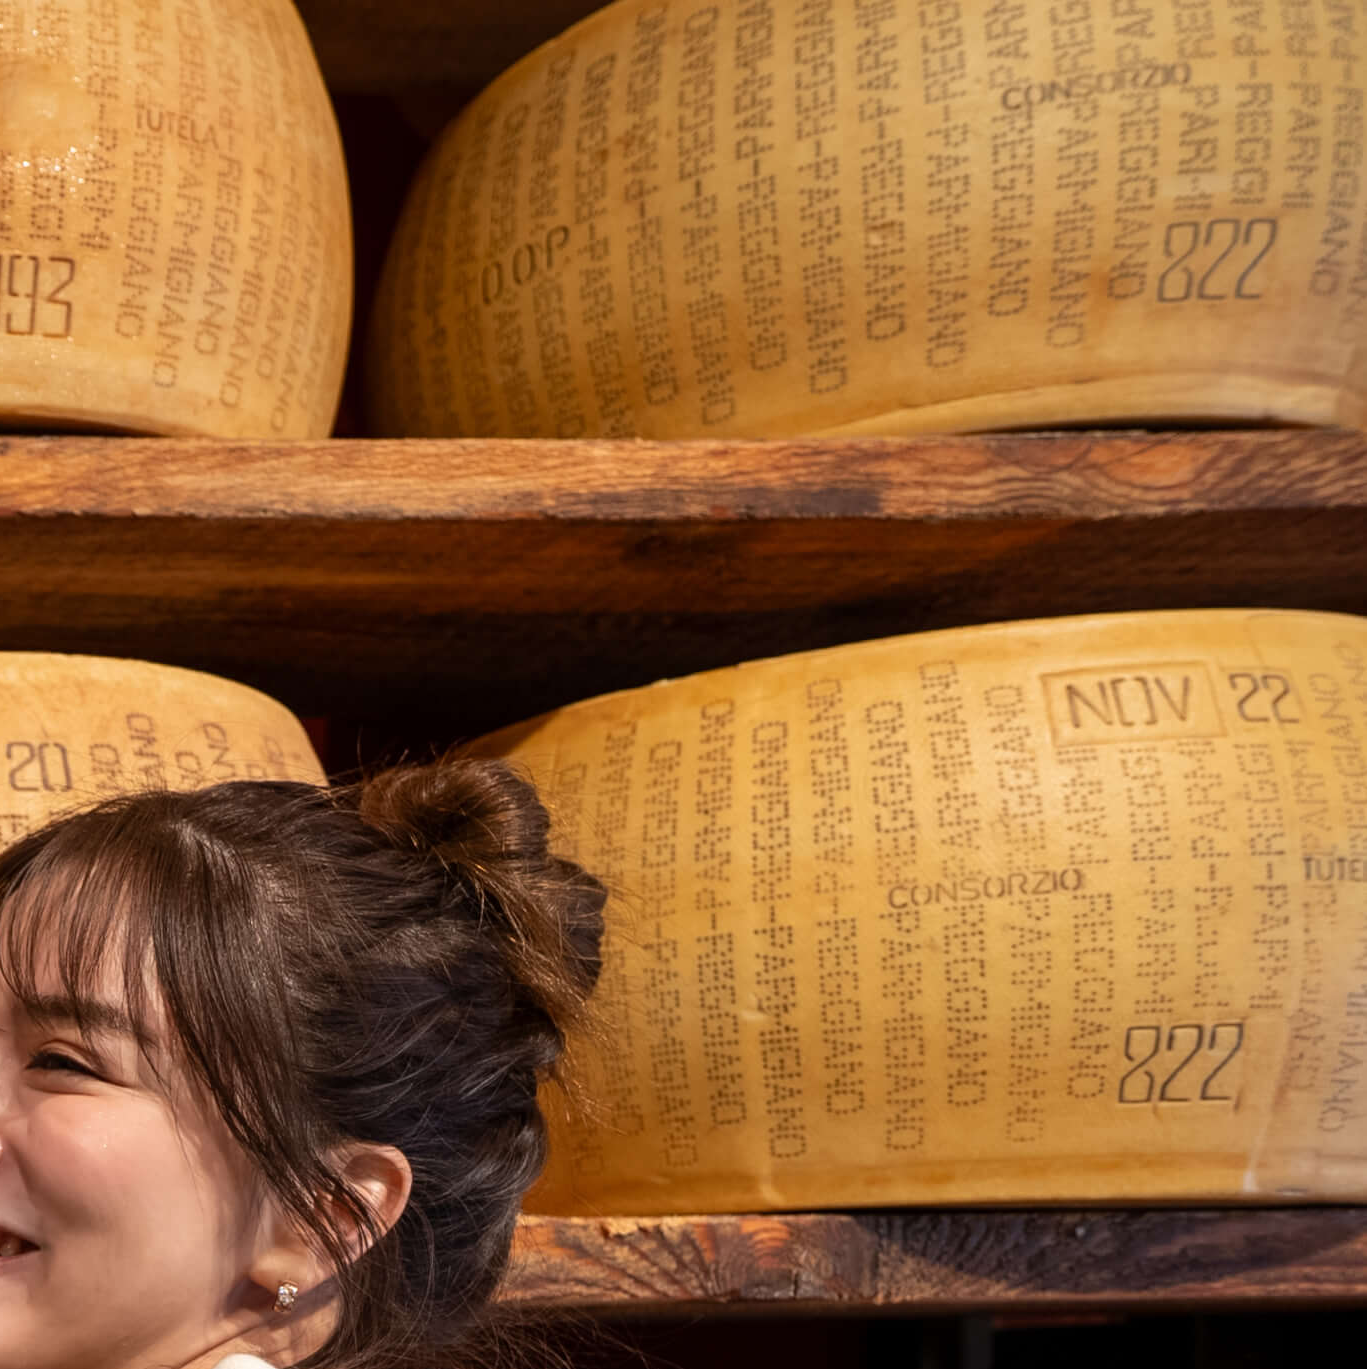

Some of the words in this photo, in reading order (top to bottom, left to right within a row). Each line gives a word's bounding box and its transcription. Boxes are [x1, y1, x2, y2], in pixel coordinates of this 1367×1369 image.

[1001, 63, 1193, 111] CONSORZIO
[134, 107, 218, 150] TUTELA
[1158, 217, 1277, 302] 822
[1066, 675, 1191, 727] NOV
[1228, 673, 1301, 724] 22
[6, 741, 73, 793] 20
[887, 867, 1083, 910] CONSORZIO
[1119, 1023, 1244, 1103] 822
